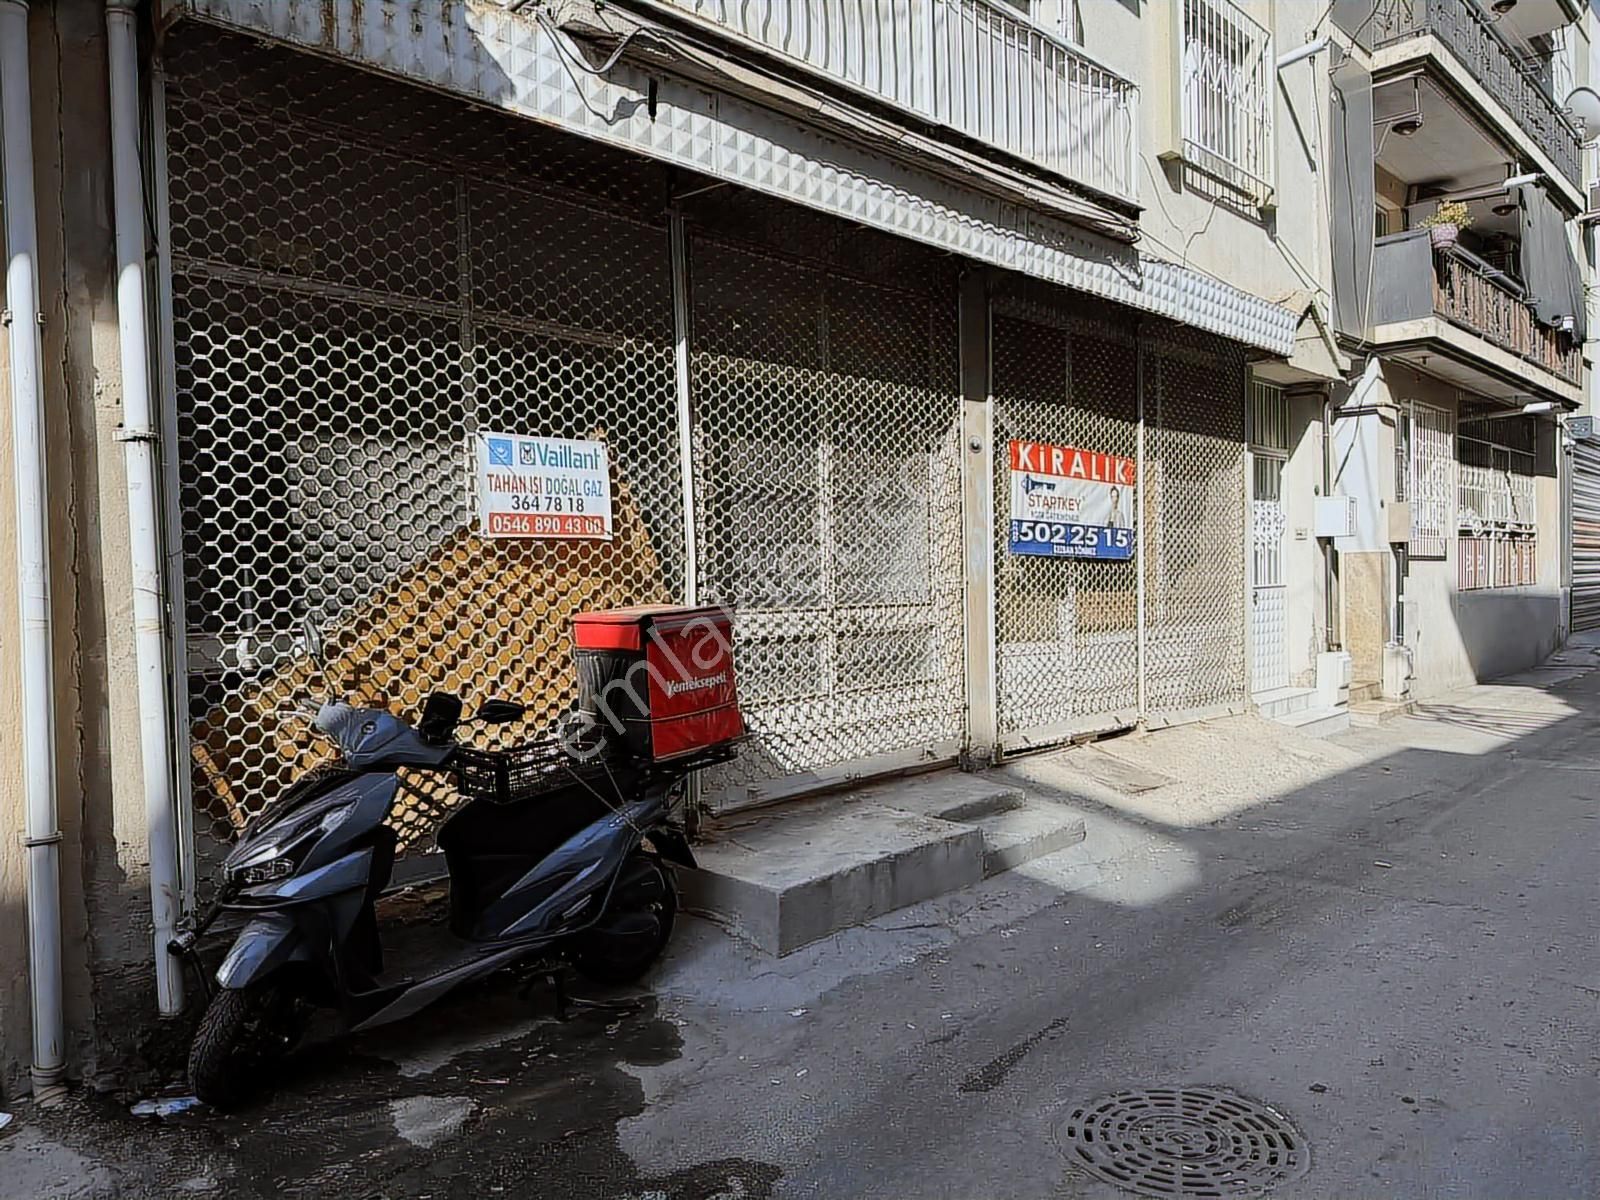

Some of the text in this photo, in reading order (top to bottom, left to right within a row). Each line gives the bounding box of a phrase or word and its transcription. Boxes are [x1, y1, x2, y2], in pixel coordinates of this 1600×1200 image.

[537, 442, 600, 470] Vaillant
[487, 474, 526, 493] TAHAN
[546, 474, 581, 496] DOĞAL
[583, 479, 603, 497] GAZ
[512, 495, 584, 512] 364 78 18
[493, 515, 530, 532] 0546
[535, 517, 560, 533] 890
[565, 518, 581, 533] 43
[1020, 522, 1066, 543] 502
[1070, 526, 1098, 546] 25
[1103, 529, 1128, 547] 15
